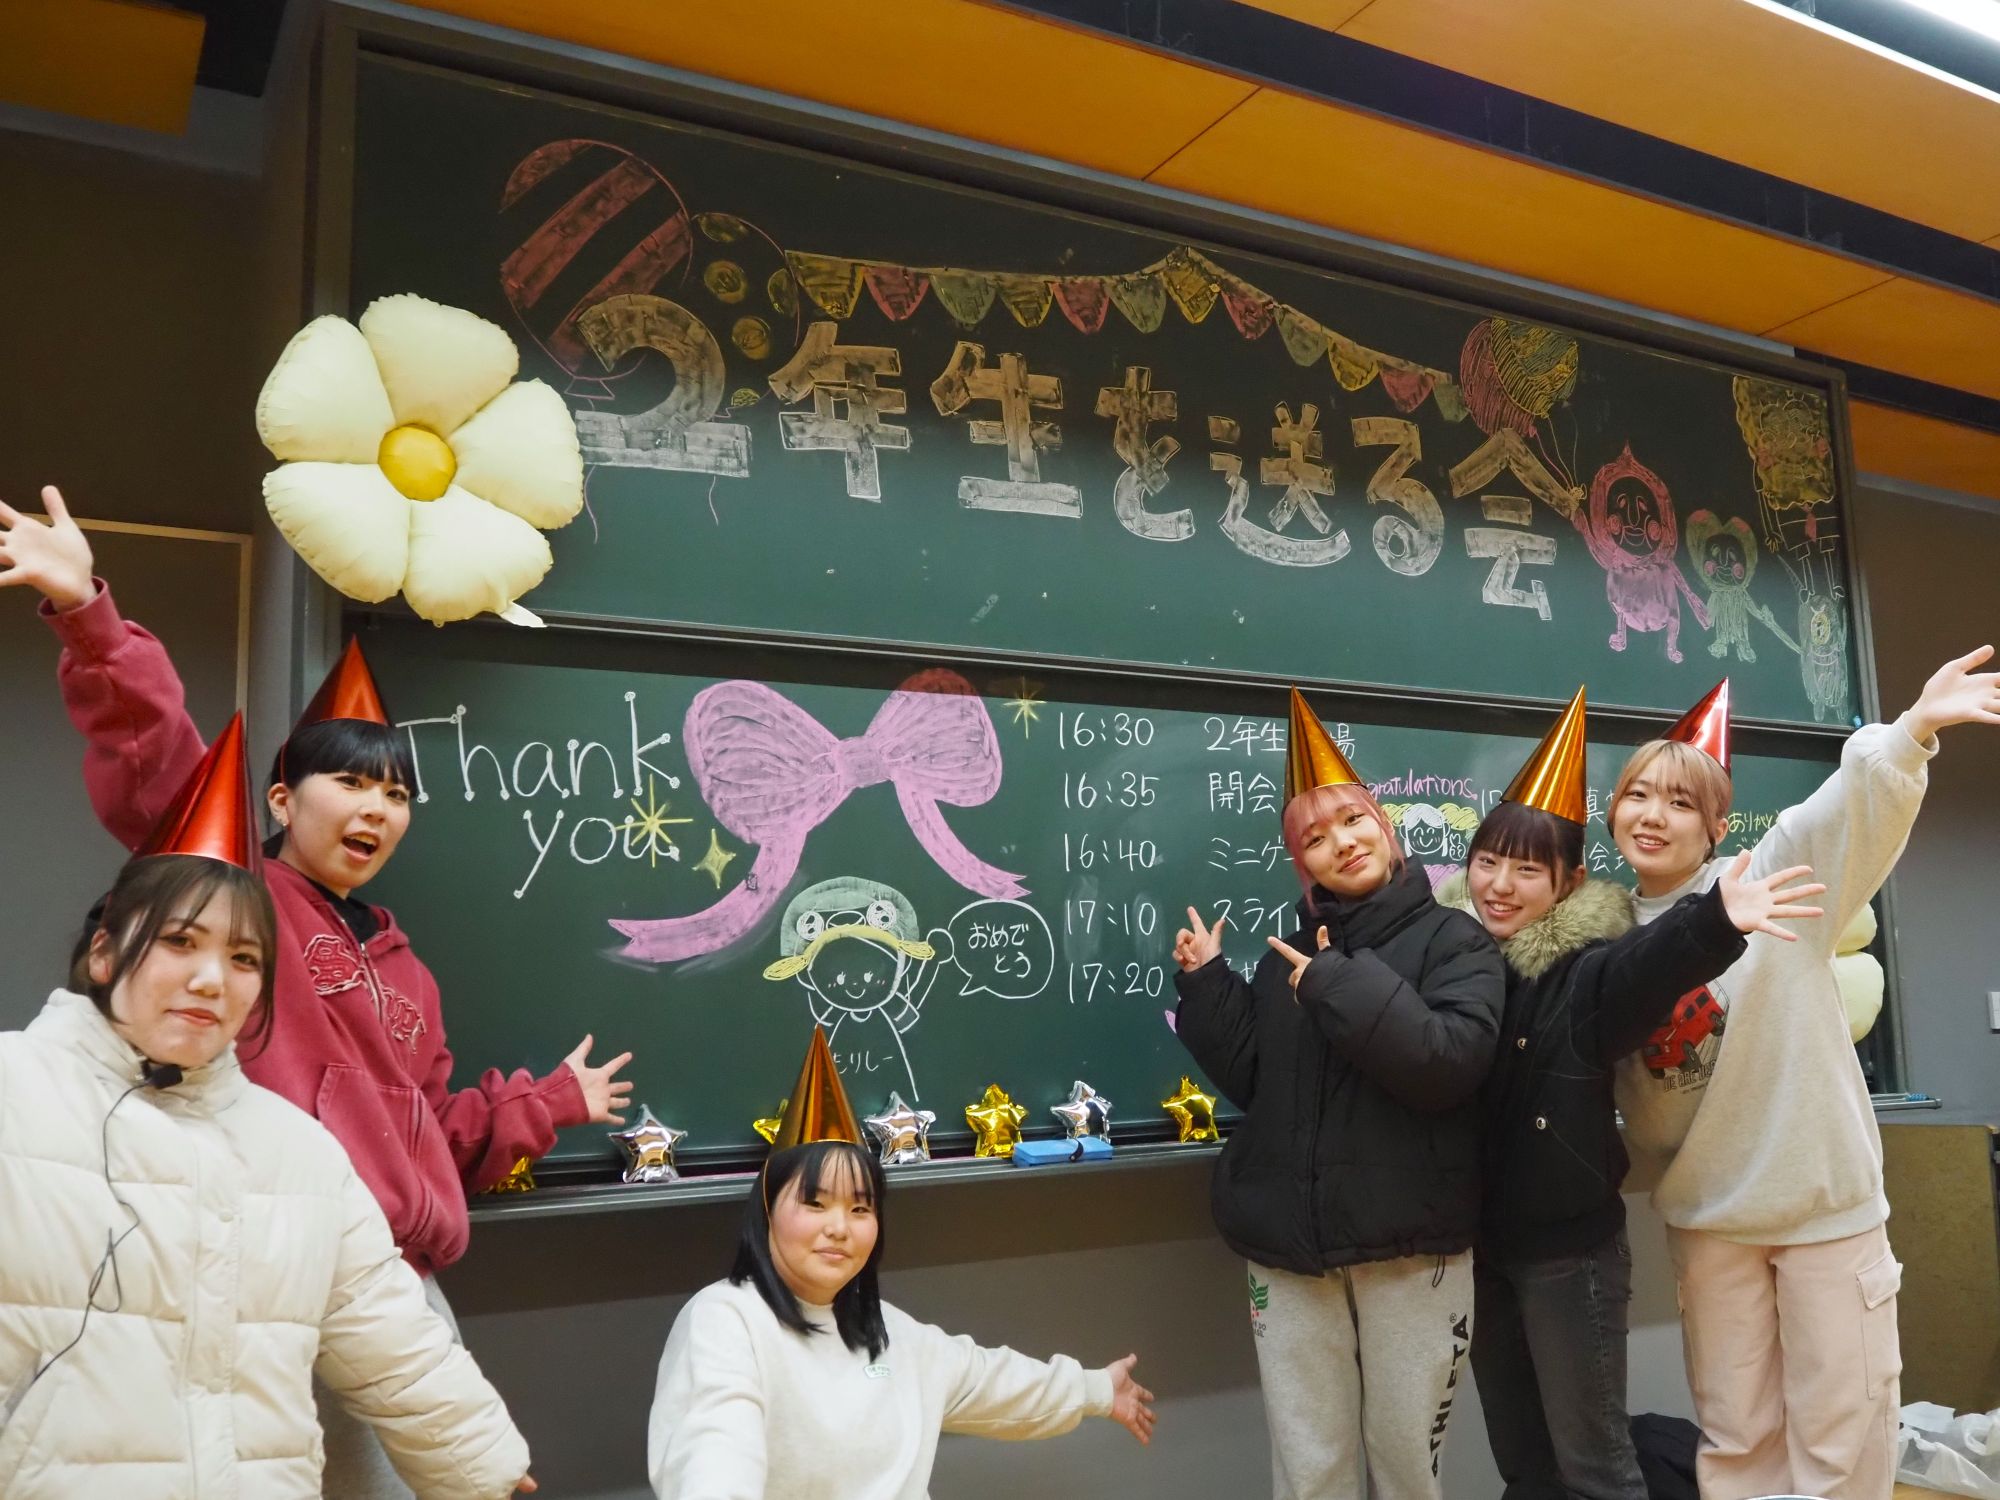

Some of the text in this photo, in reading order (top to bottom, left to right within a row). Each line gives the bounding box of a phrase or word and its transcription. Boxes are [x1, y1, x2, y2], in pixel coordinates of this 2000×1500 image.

[573, 293, 1581, 621] 2年生を送る会
[395, 691, 680, 803] Thank
[1059, 712, 1154, 749] 16:30
[1065, 771, 1160, 808] 16:35
[1208, 771, 1284, 814] 開会
[513, 809, 681, 899] you
[1064, 833, 1157, 872] 16:40
[968, 921, 1030, 949] おめで
[1067, 900, 1157, 936] 17:10
[994, 951, 1032, 978] とう
[1069, 962, 1163, 1004] 17:20
